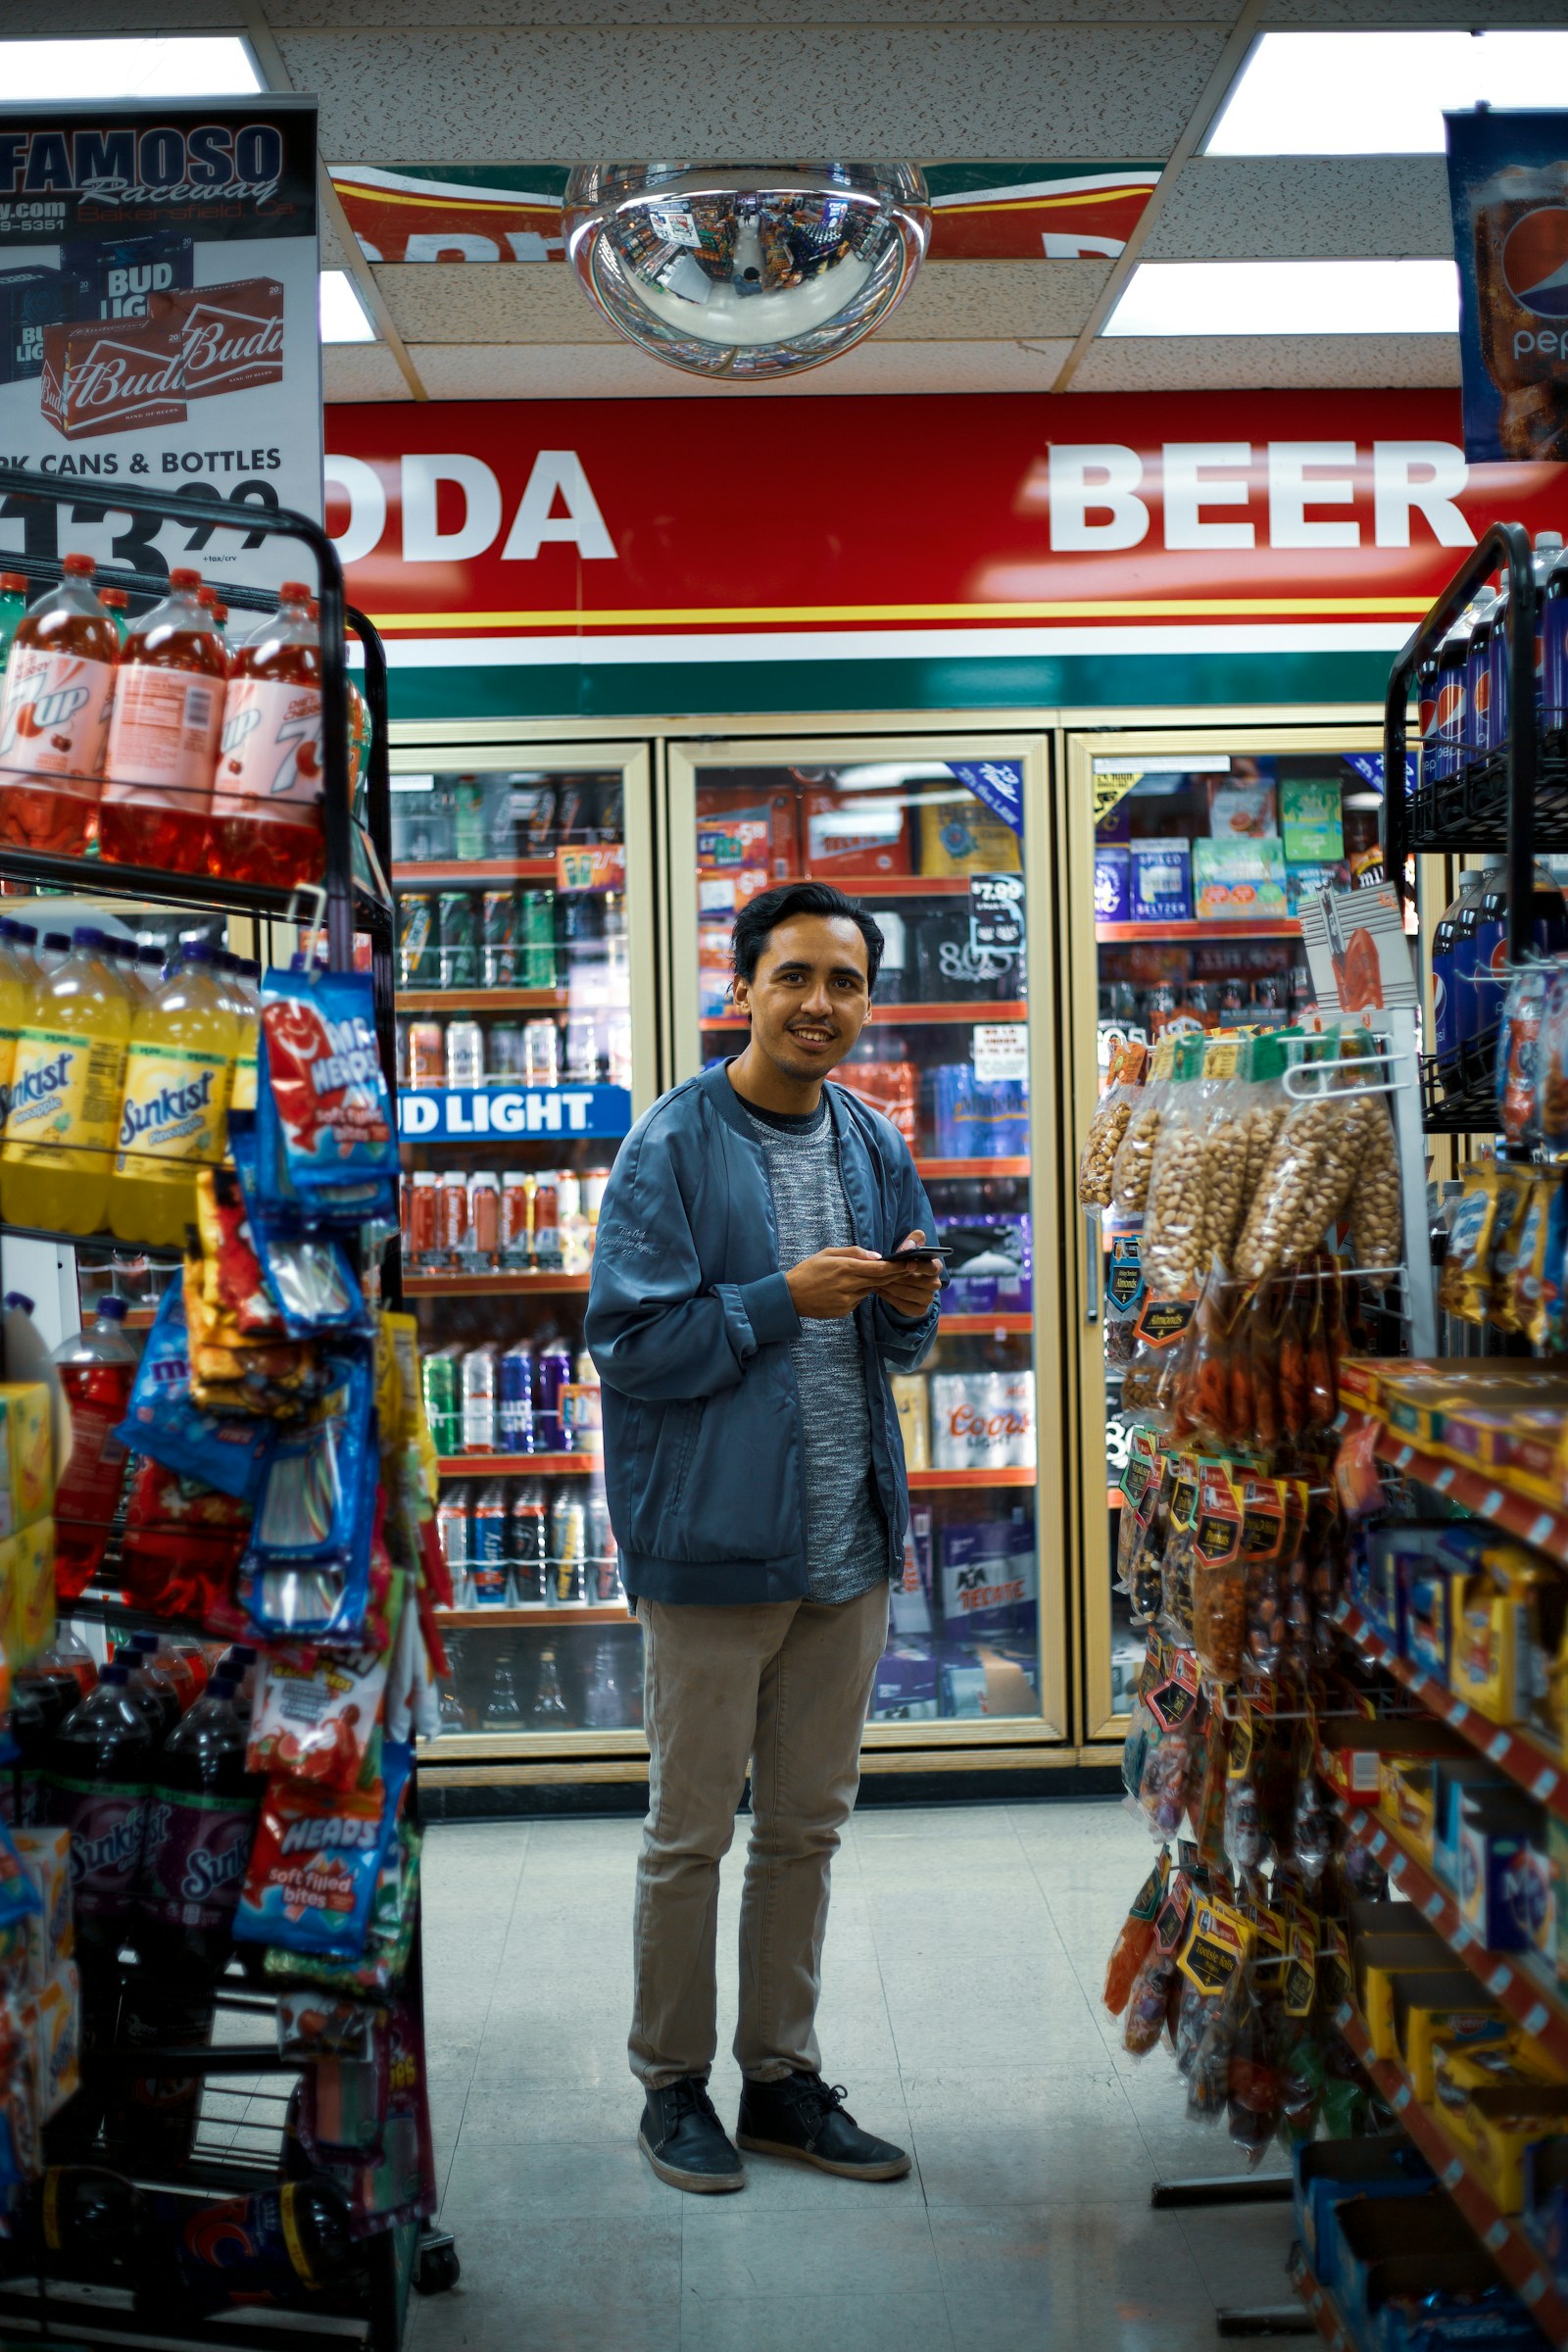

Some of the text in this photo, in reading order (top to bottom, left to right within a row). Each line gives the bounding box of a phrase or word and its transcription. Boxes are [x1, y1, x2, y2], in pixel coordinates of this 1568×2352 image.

[0, 124, 283, 193] FAMOSO
[77, 176, 278, 206] Raceway
[108, 262, 172, 298] BUD
[40, 454, 119, 475] CANS
[128, 454, 151, 474] &
[161, 448, 282, 473] BOTTLES
[1048, 441, 1478, 552] BEER
[1136, 902, 1187, 915] SELTZER
[120, 1069, 215, 1146] Sunkist
[446, 1093, 594, 1133] LIGHT
[148, 1114, 206, 1146] Pineapple
[1115, 1276, 1138, 1290] Almonds
[1149, 1314, 1184, 1327] Almonds
[947, 1403, 1030, 1438] Coors
[958, 1579, 1026, 1611] TECATE
[281, 1817, 379, 1856] HEADS
[268, 1866, 353, 1894] soft filled
[281, 1885, 327, 1909] bites
[1196, 1941, 1219, 1964] Tootsie
